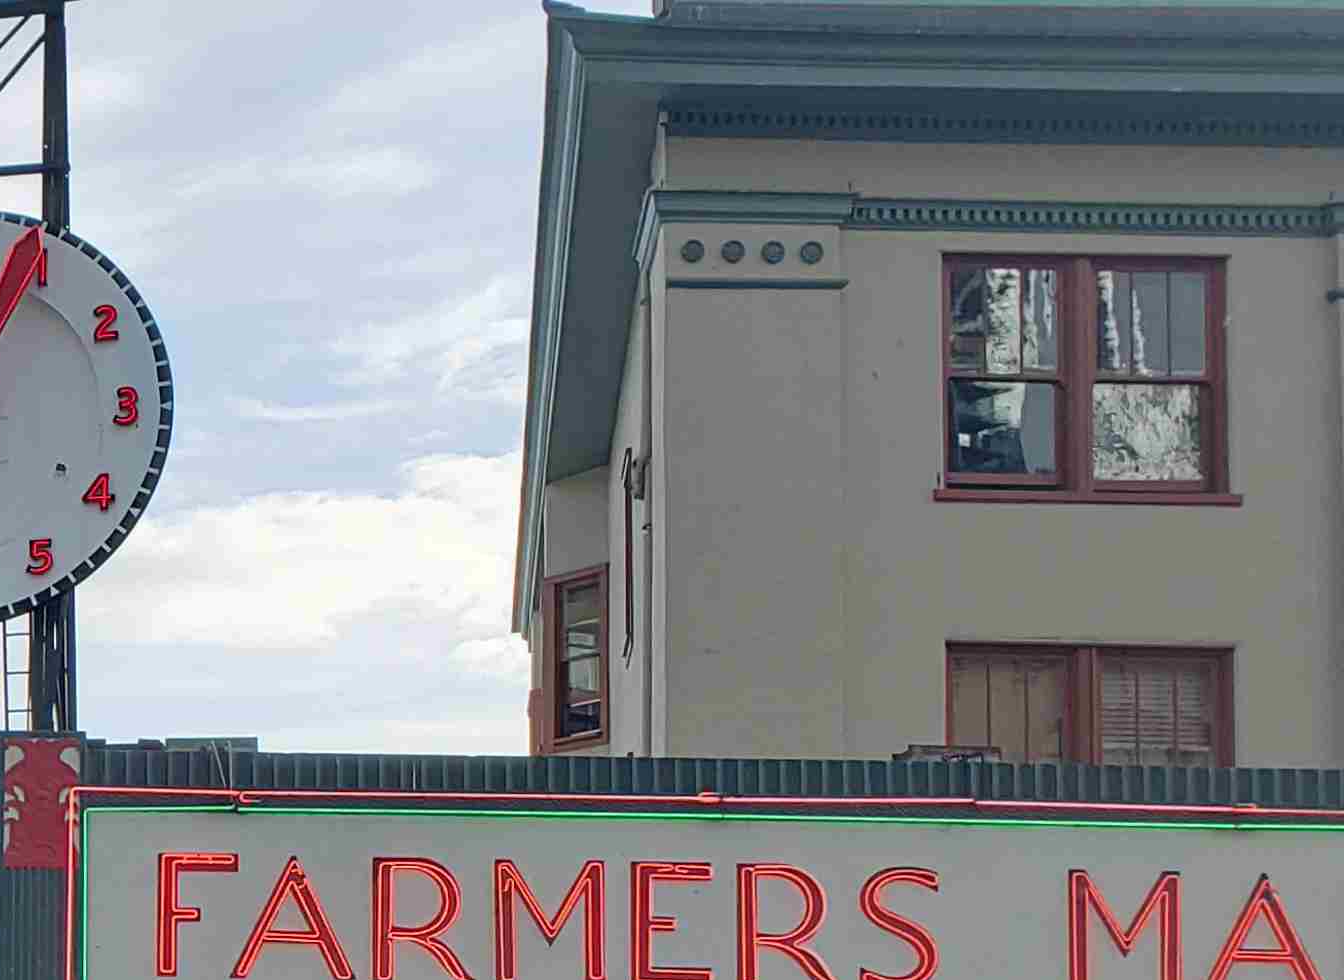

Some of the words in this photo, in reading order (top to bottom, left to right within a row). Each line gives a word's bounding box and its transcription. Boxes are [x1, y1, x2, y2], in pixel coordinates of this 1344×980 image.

[36, 247, 49, 288] 1
[93, 304, 120, 343] 2
[113, 386, 140, 426] 3
[81, 473, 115, 512] 4
[26, 538, 55, 576] 5
